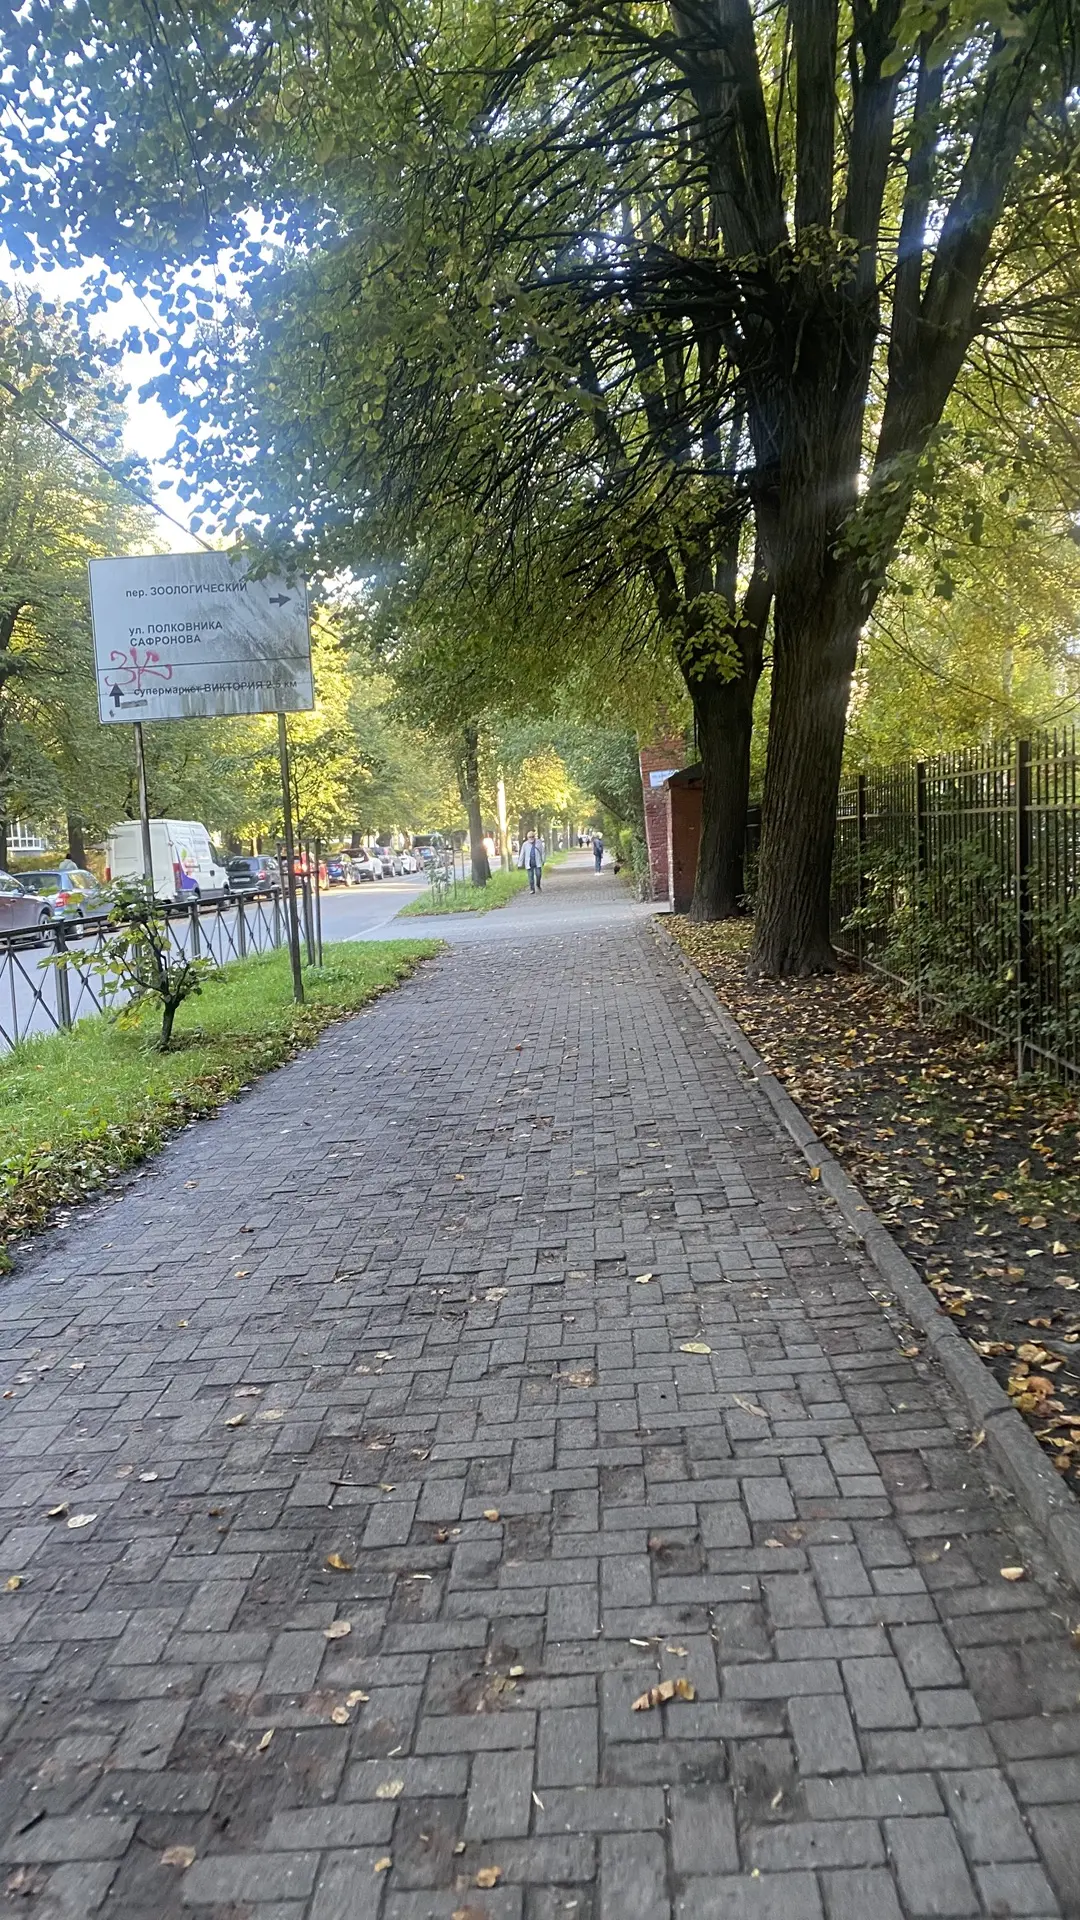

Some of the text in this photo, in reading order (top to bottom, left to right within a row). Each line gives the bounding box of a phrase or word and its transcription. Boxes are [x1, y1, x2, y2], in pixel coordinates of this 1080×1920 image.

[125, 580, 247, 598] пер. ЗООЛОГИЧЕСКИЙ
[128, 620, 223, 637] ул. ПОЛКОВНИКА
[130, 634, 202, 647] САФРОНОВА
[133, 684, 202, 698] супермаркет
[204, 680, 263, 692] ВИКТОРИЯ
[284, 680, 298, 689] км
